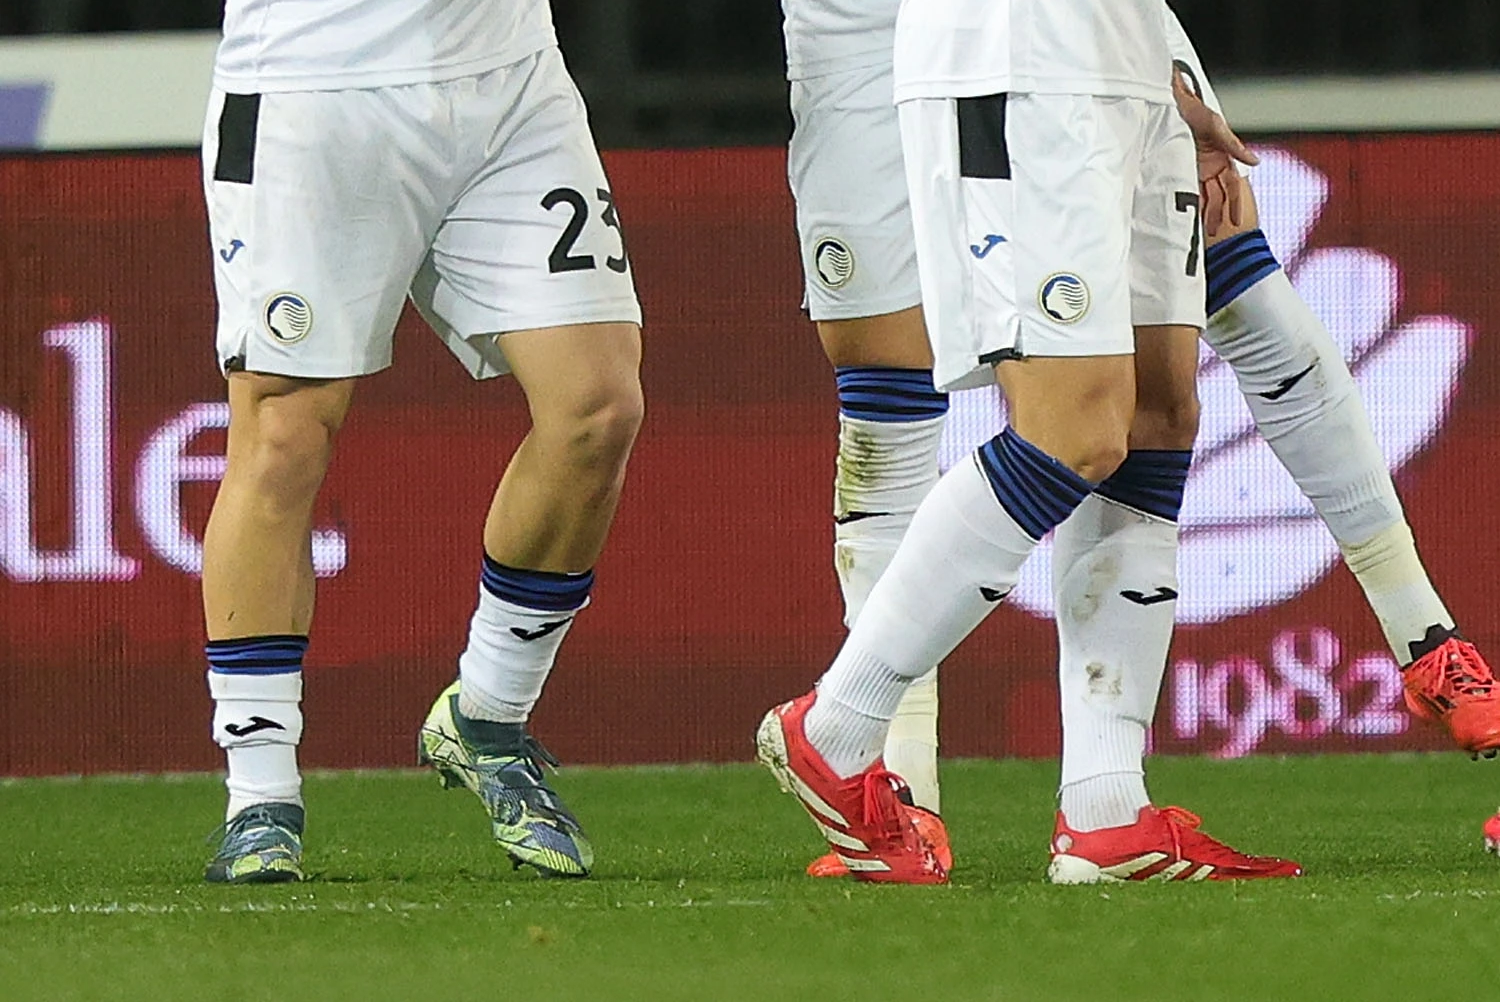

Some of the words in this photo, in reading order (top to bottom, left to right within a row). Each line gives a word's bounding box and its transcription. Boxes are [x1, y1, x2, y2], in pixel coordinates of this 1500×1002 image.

[540, 187, 628, 274] 23
[1175, 191, 1200, 277] 7
[1172, 627, 1410, 760] 1982
